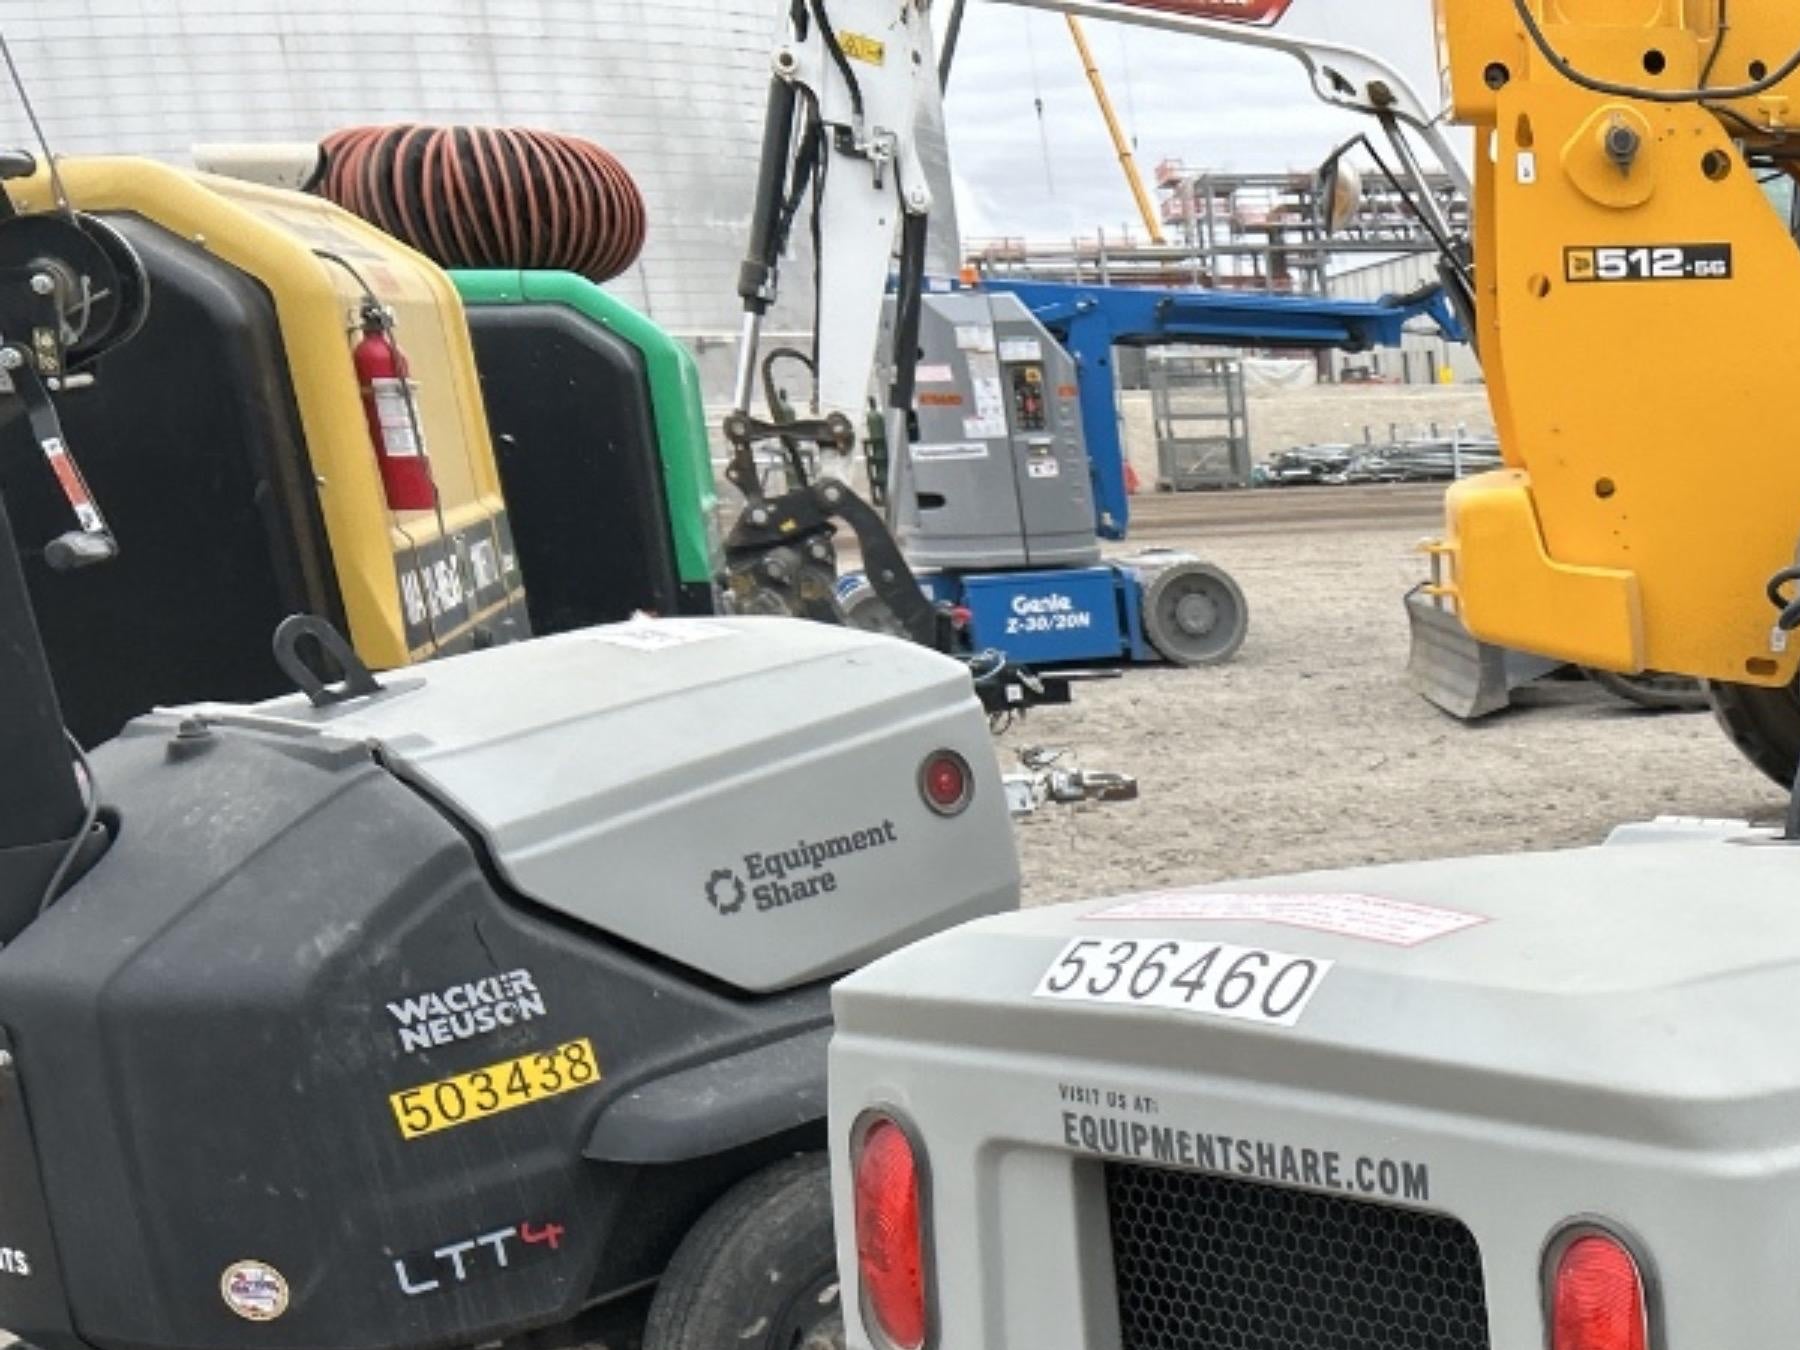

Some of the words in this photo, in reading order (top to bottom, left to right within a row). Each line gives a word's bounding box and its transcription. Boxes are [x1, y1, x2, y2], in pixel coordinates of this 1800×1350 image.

[1011, 592, 1073, 616] Genie
[744, 818, 897, 880] Equipment
[752, 870, 838, 912] Share
[386, 967, 538, 1027] WACKER
[1048, 940, 1318, 1019] 536460
[398, 992, 547, 1053] NEUSON
[399, 1042, 593, 1133] 503438
[1059, 1082, 1099, 1105] VISIT
[1106, 1091, 1127, 1110] US
[1062, 1111, 1430, 1201] EQUIPMENTSHARE.COM
[394, 1221, 566, 1295] LTT4
